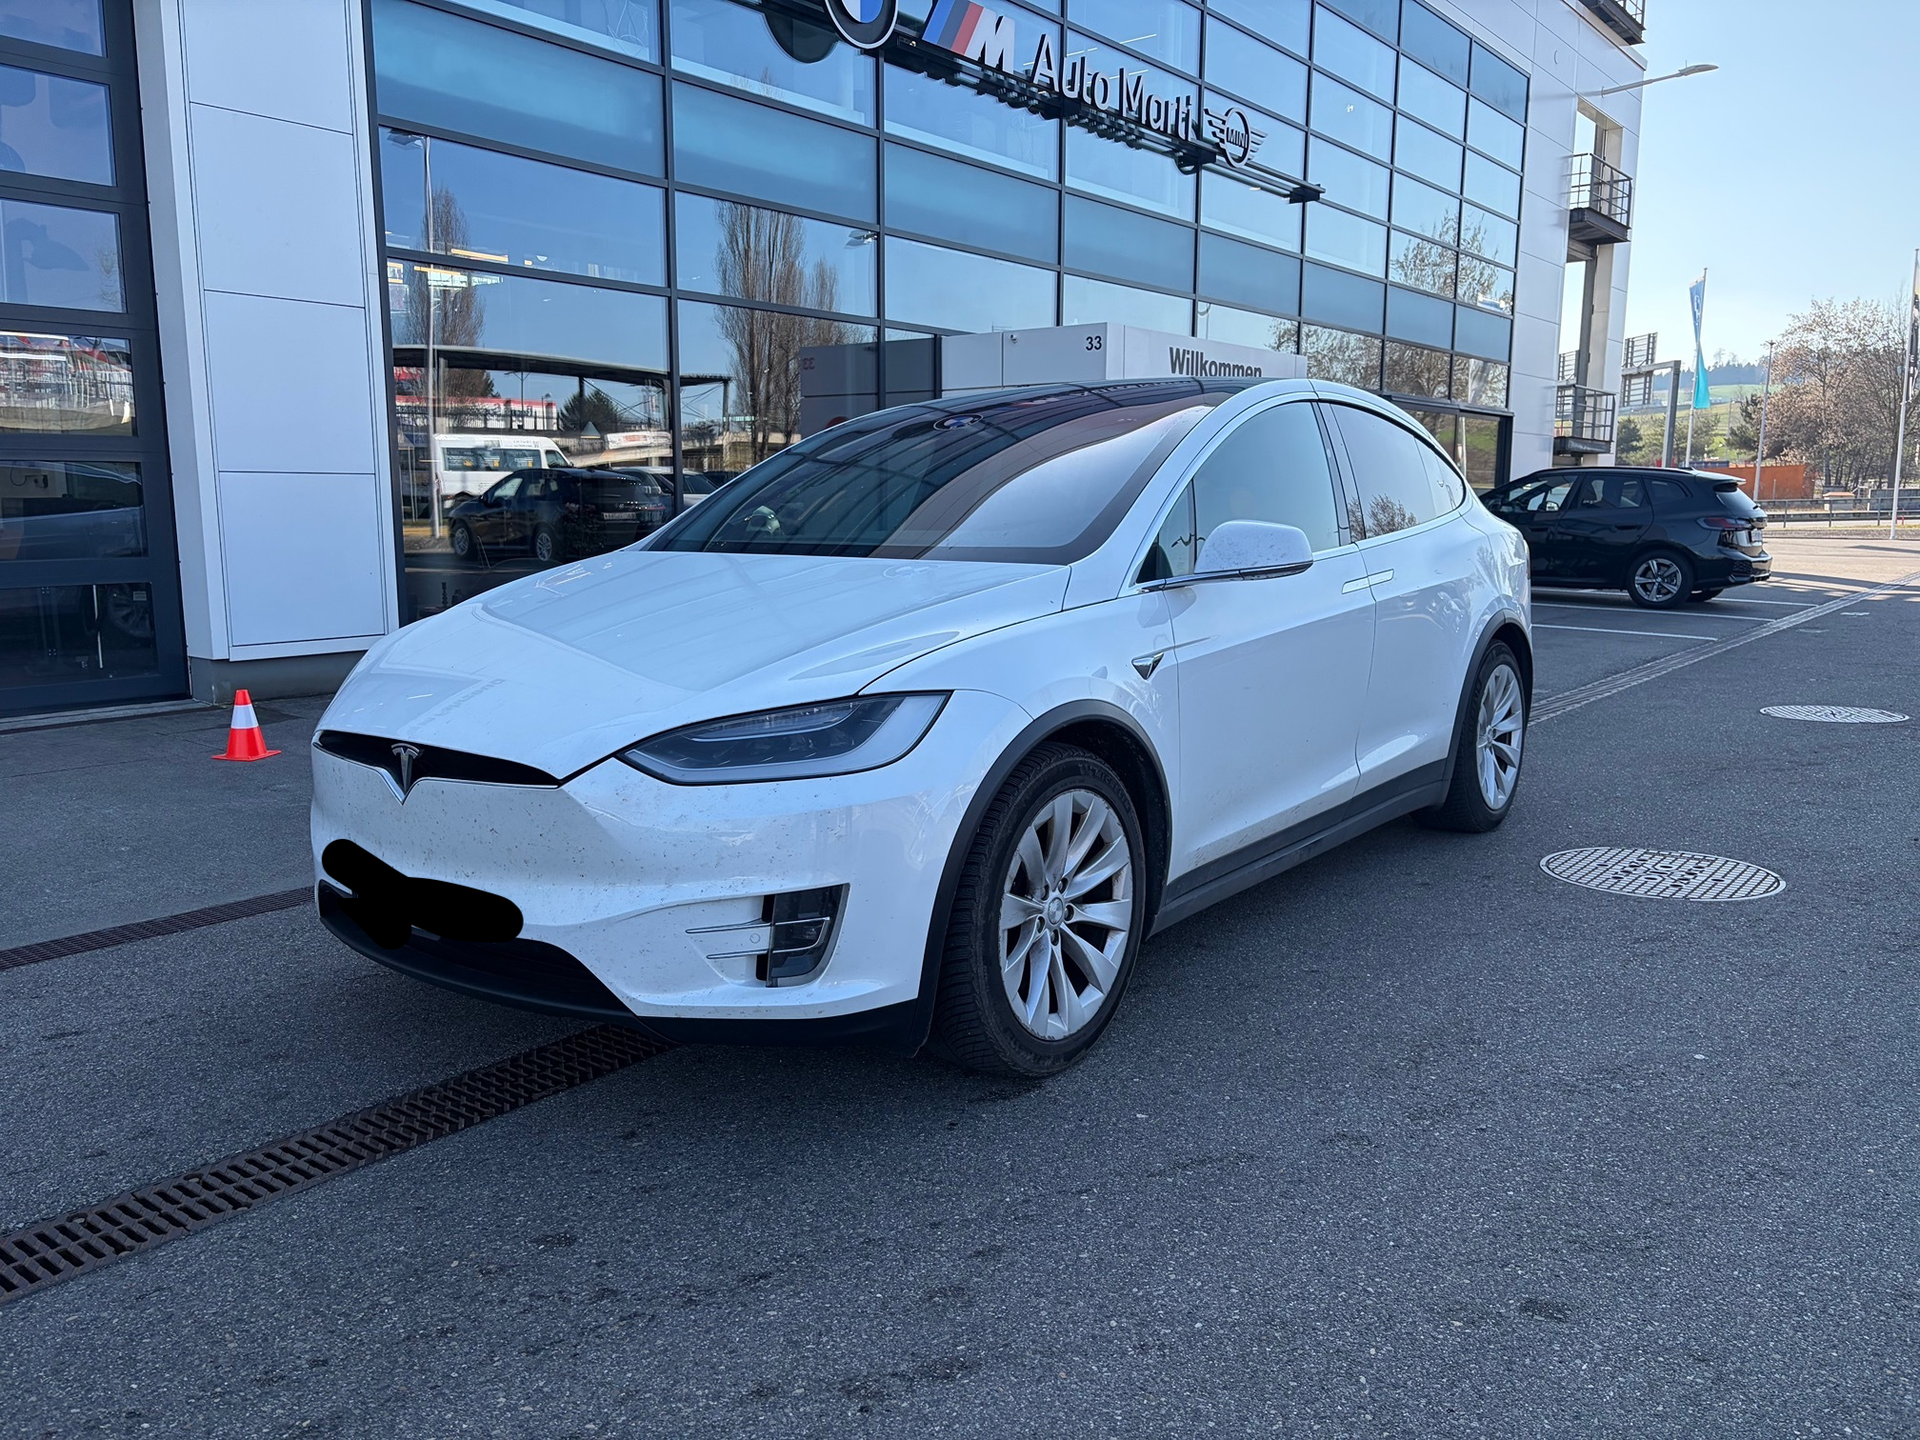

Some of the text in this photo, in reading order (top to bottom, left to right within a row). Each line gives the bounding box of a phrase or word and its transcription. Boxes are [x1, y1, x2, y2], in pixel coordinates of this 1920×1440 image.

[1030, 33, 1193, 141] Auto Marti
[1227, 127, 1248, 149] MINI
[1085, 335, 1102, 351] 33
[1169, 346, 1263, 377] Willkommen
